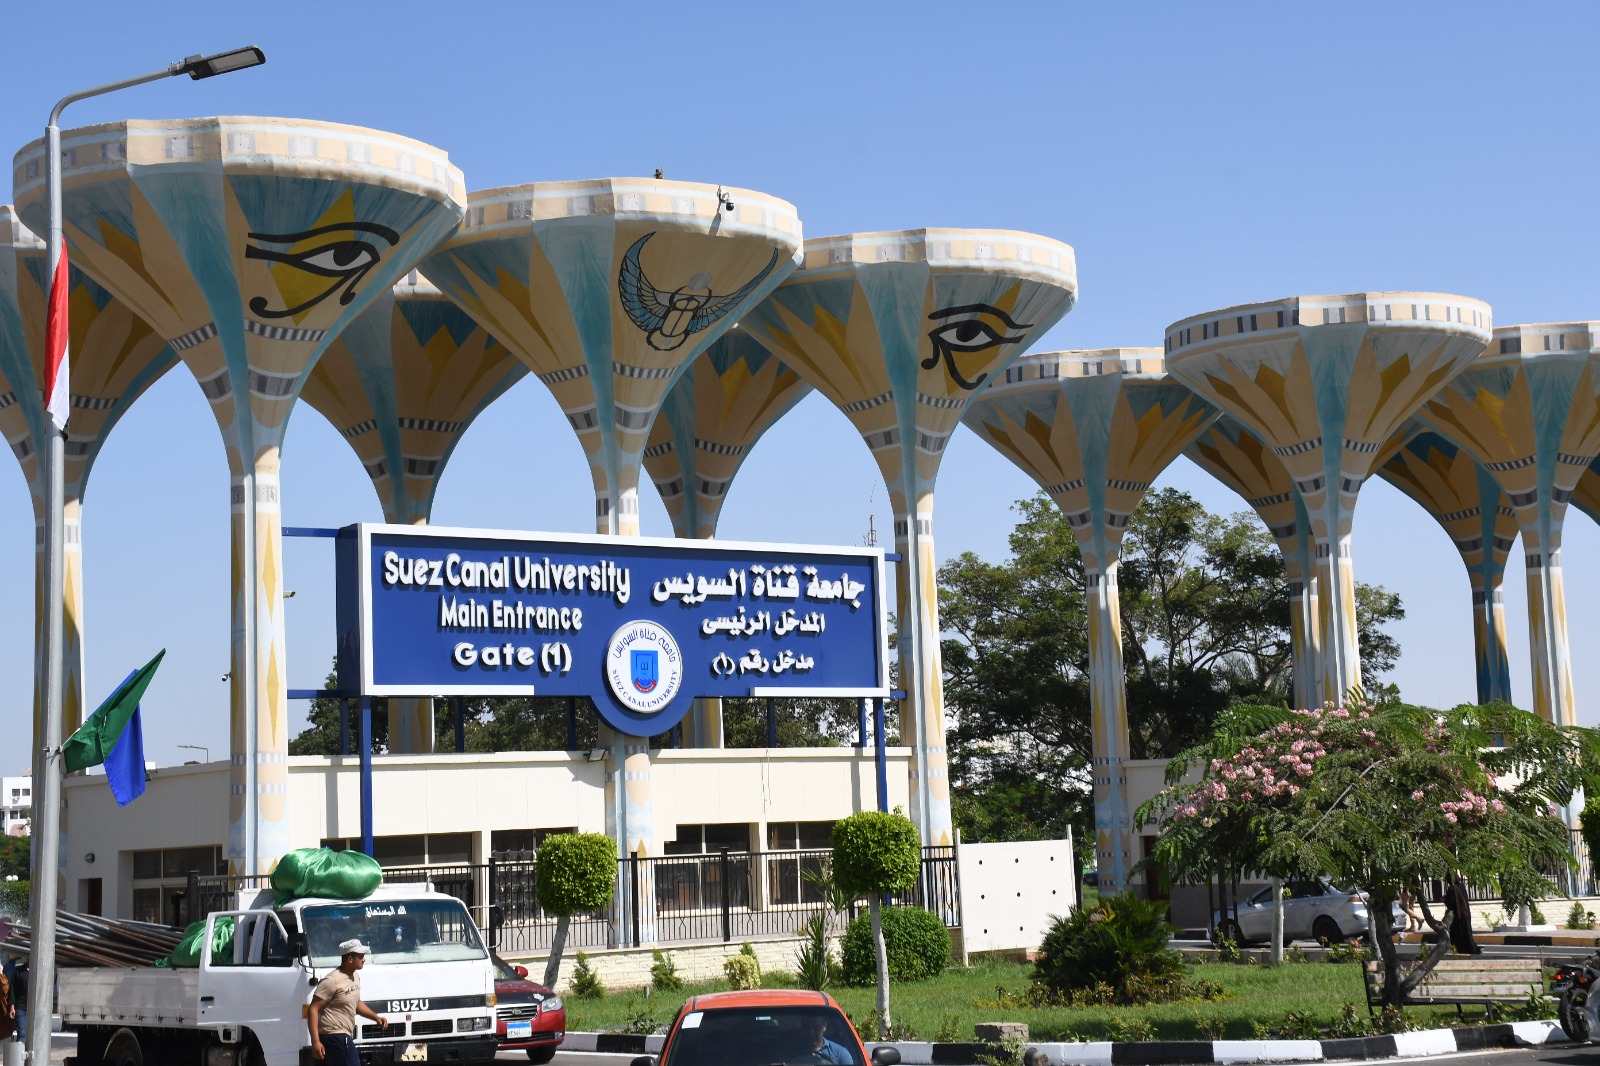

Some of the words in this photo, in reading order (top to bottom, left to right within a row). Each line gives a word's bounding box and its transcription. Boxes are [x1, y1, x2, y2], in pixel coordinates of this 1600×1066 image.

[383, 550, 444, 586] Suez
[446, 553, 510, 589] Canal
[514, 556, 631, 604] University
[653, 568, 746, 604] السويس
[750, 564, 801, 599] قناة
[802, 566, 866, 608] جامعة
[441, 595, 489, 628] Main
[493, 600, 583, 631] Entrance
[774, 609, 826, 636] المدخل
[454, 642, 535, 667] Gate
[541, 642, 573, 673] (1)
[739, 649, 770, 676] رقم
[772, 650, 815, 673] مدخل
[613, 669, 625, 691] SUEZ
[623, 691, 646, 707] CANAL
[647, 669, 677, 707] UNIVERSITY
[387, 999, 429, 1013] ISUZU
